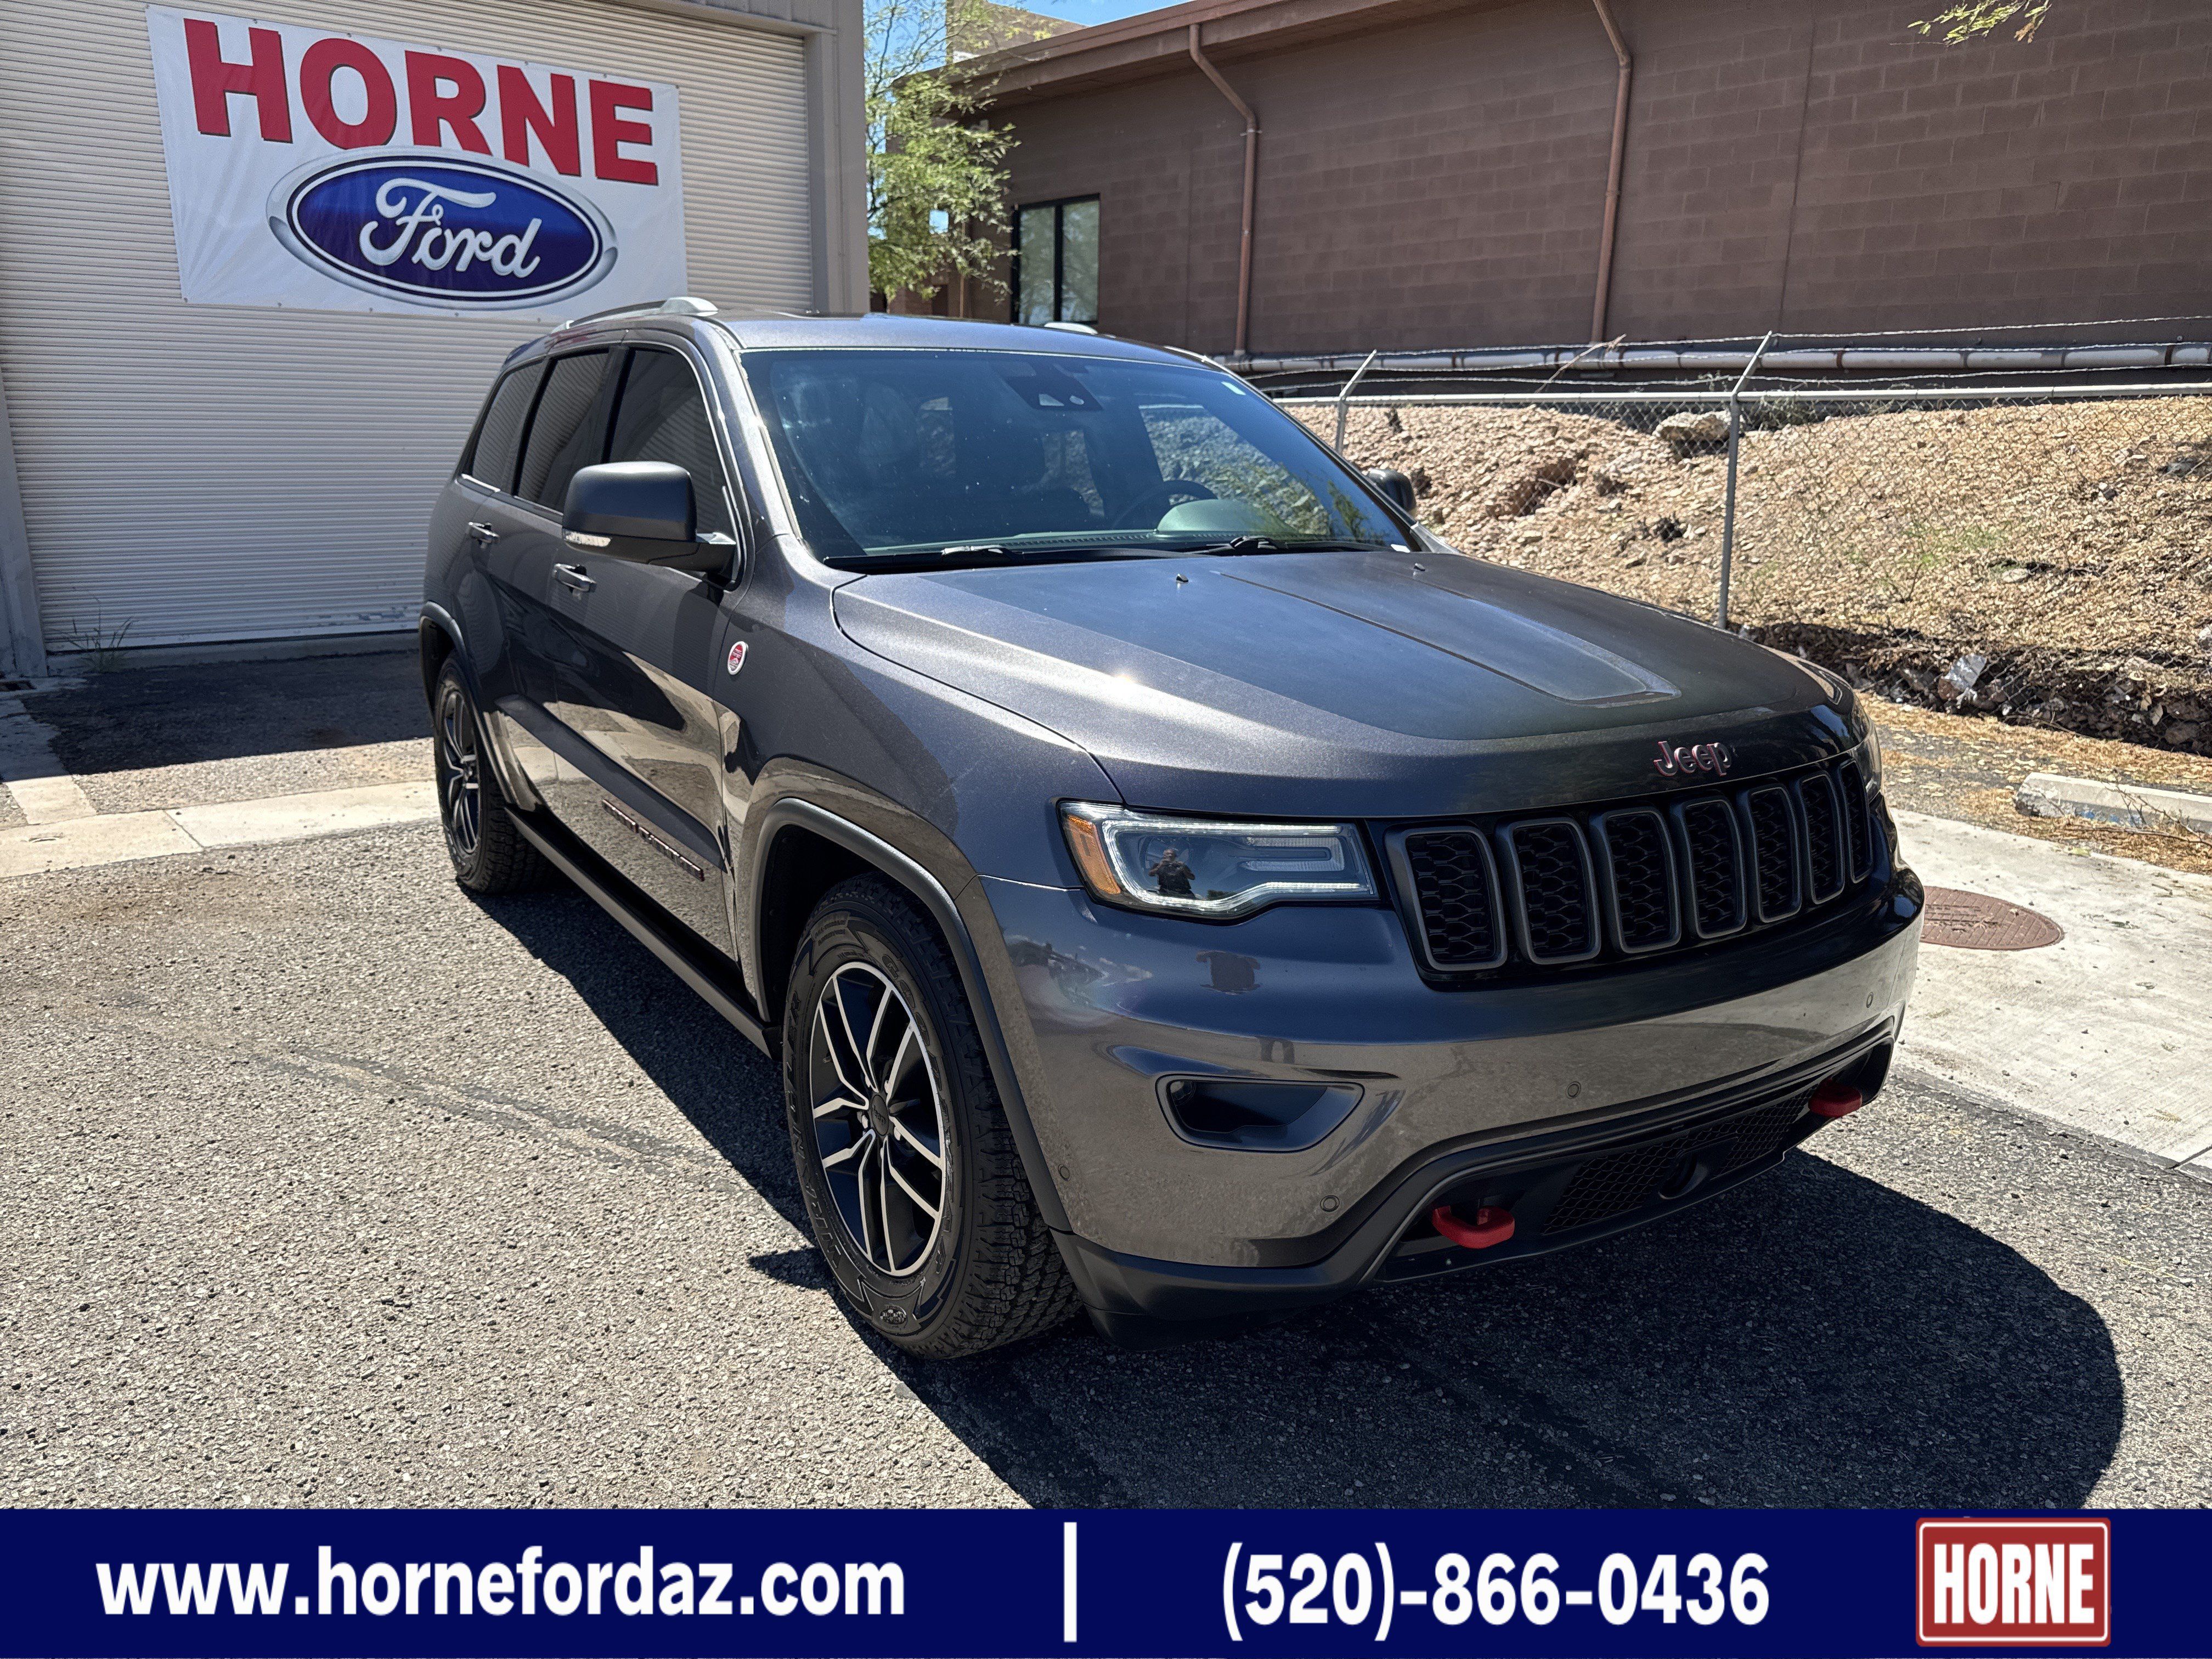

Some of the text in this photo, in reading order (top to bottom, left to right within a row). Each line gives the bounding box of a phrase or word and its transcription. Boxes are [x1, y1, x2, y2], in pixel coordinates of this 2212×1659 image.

[184, 18, 658, 185] HORNE
[359, 177, 543, 278] Ford
[1653, 740, 1733, 777] Jeep
